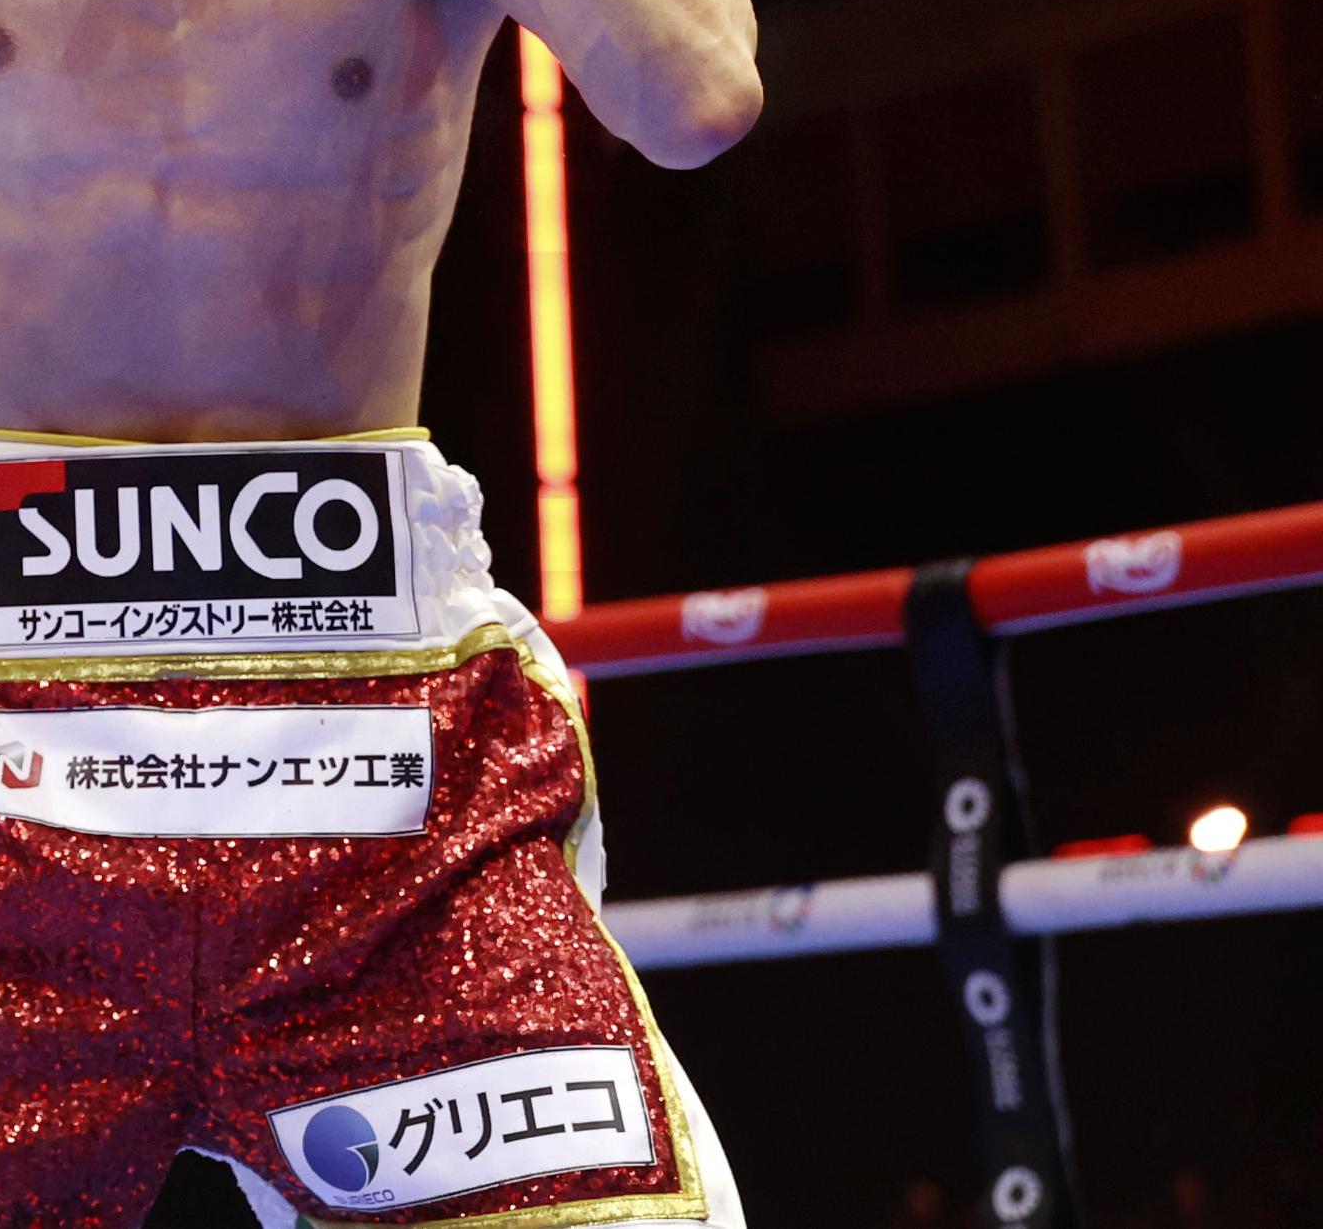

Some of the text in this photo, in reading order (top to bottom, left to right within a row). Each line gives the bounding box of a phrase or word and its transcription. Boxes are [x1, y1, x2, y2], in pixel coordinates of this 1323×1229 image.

[15, 470, 380, 581] SUNCO
[18, 599, 374, 641] サンコーインダストリー株式会社
[65, 752, 425, 790] 株式会社ナンエツ工業
[387, 1078, 627, 1175] グリエコ
